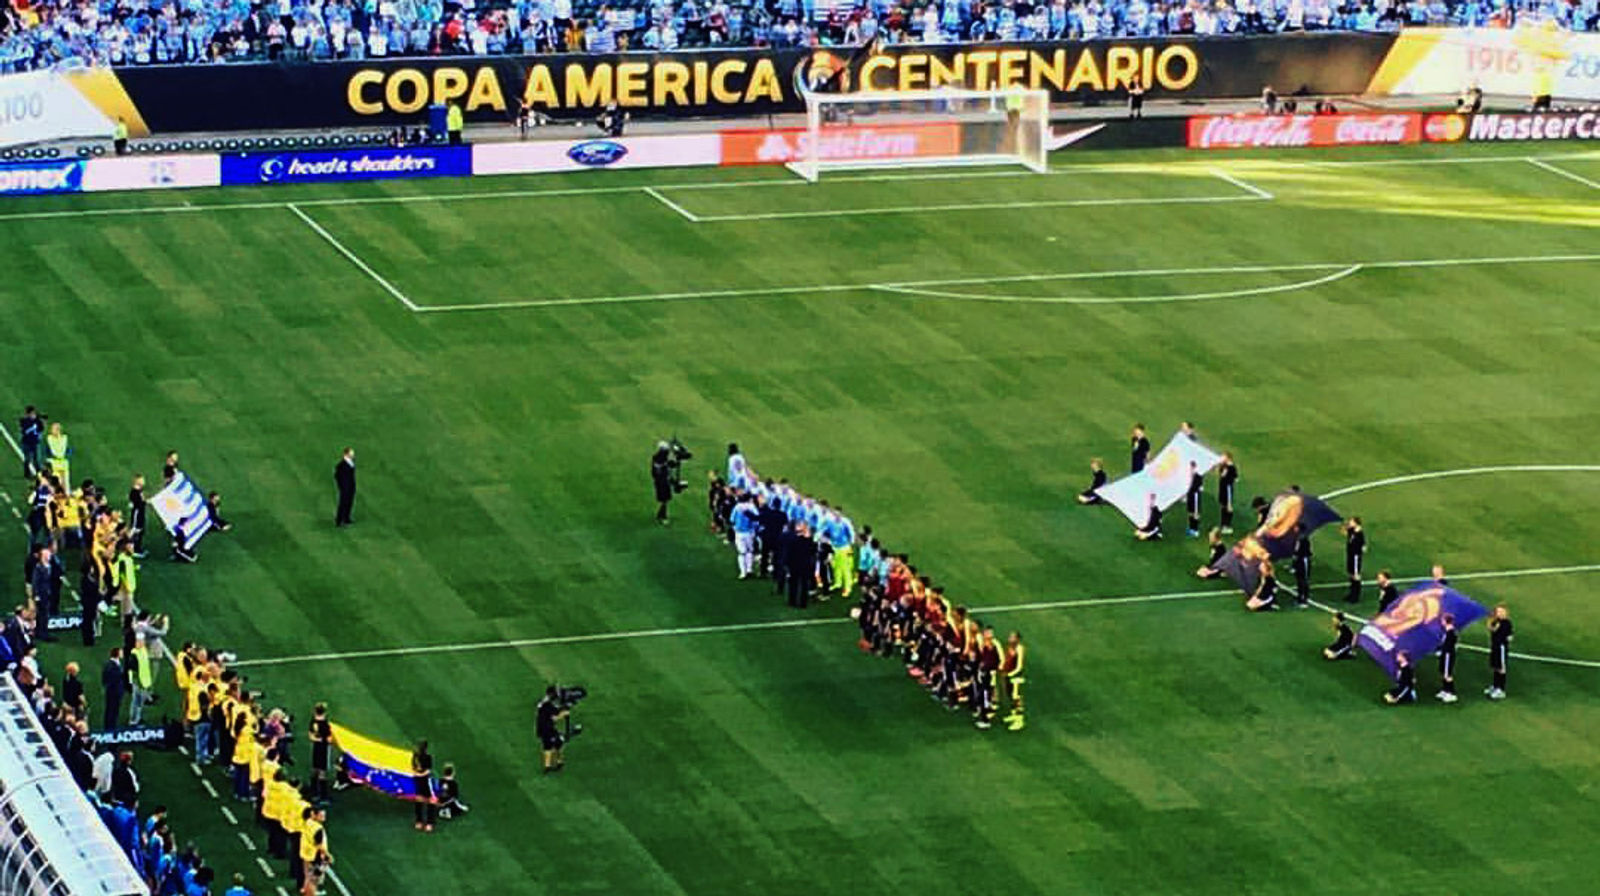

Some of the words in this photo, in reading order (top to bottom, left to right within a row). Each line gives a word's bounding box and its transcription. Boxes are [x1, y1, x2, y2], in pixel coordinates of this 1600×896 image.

[1467, 43, 1521, 74] 1916
[347, 67, 505, 115] COPA
[524, 58, 783, 109] AMERICA
[859, 44, 1198, 92] CENTENARIO
[350, 154, 436, 173] shoulders
